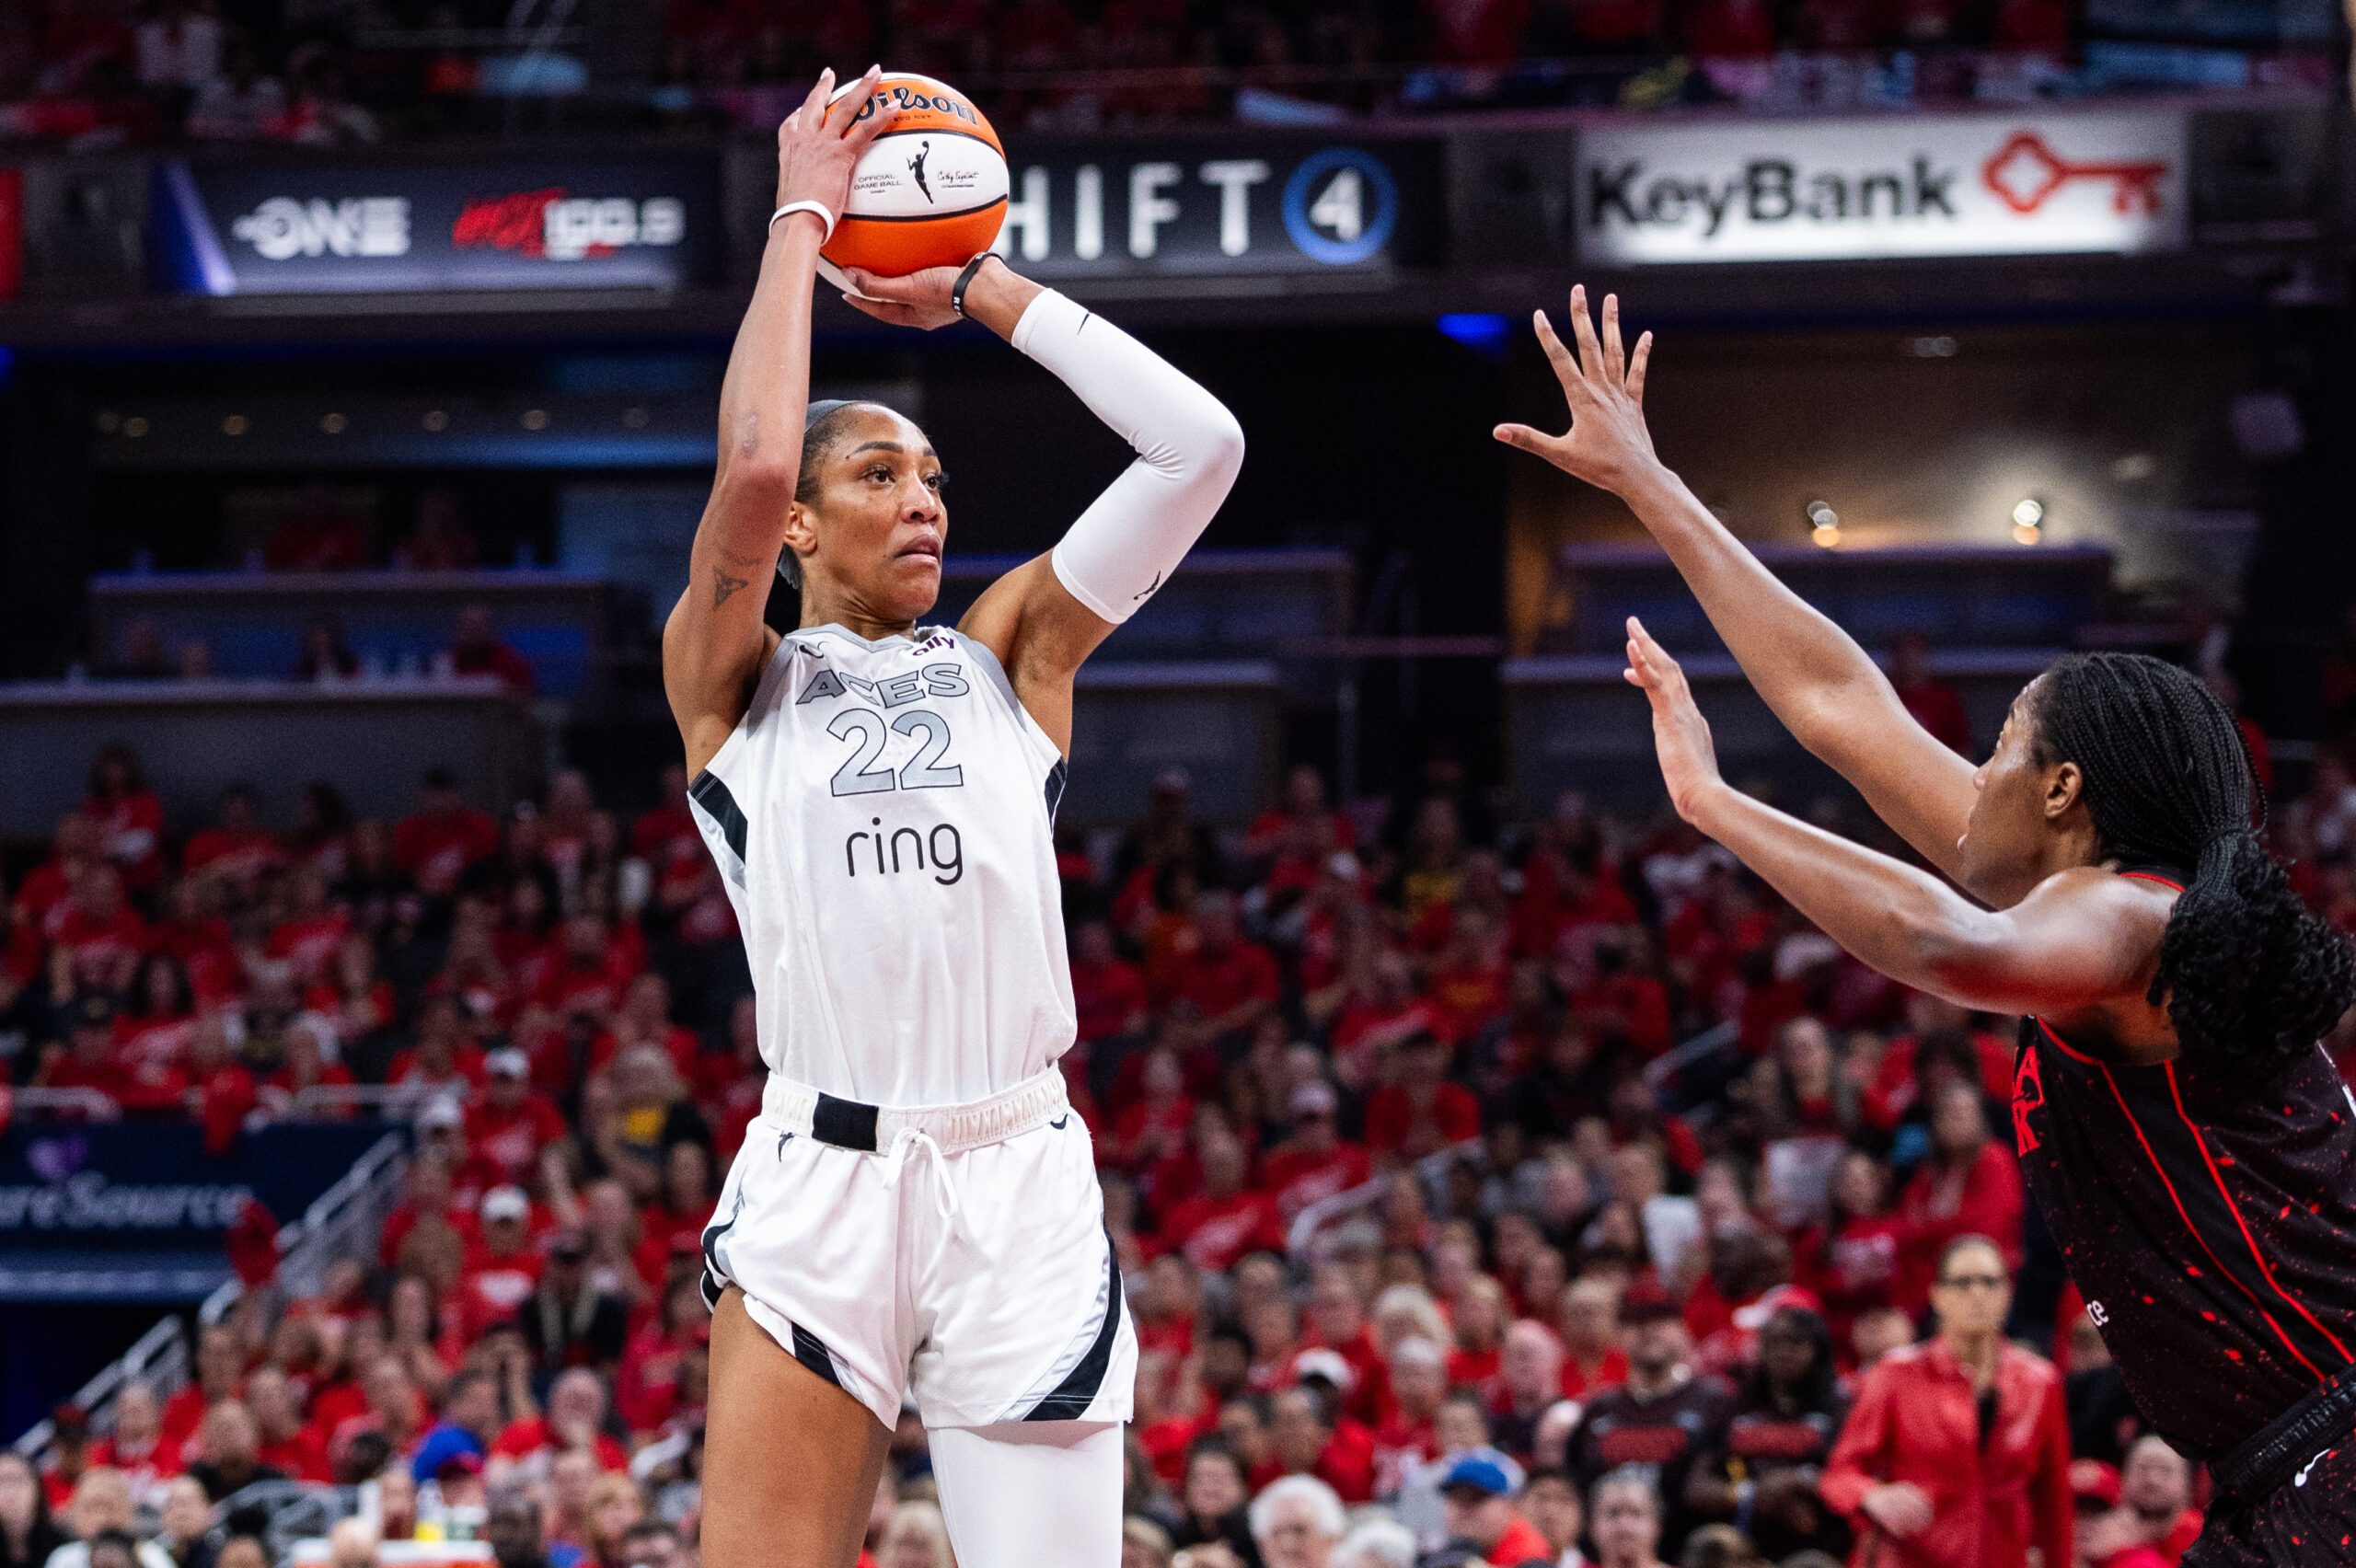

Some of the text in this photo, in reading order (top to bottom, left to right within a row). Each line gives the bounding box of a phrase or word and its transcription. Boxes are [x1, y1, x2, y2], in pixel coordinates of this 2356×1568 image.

[854, 182, 879, 190] GAME
[858, 174, 895, 182] OFFICIAL
[1588, 152, 1956, 239] KeyBank
[996, 158, 1362, 261] HIFT 4
[912, 635, 954, 656] ally
[795, 663, 970, 709] ACES
[826, 708, 964, 797] 22
[846, 816, 963, 885] ring
